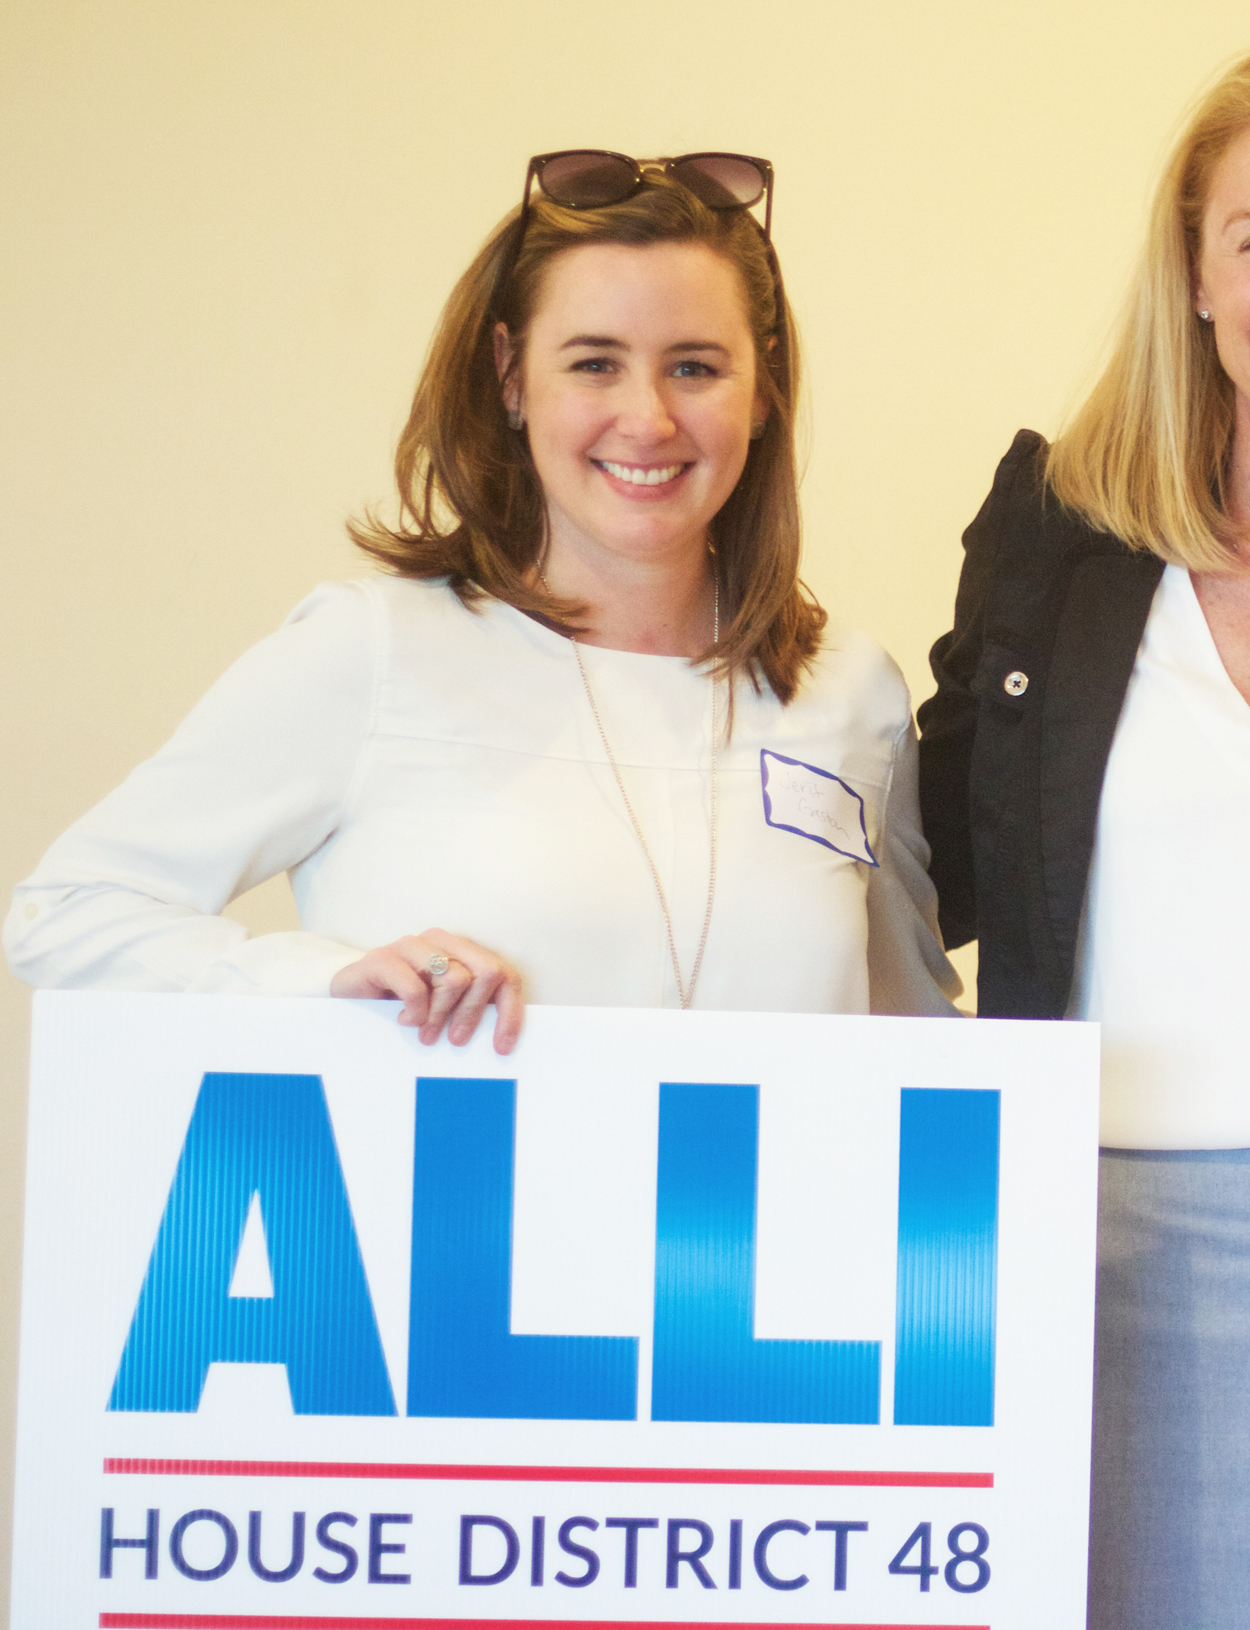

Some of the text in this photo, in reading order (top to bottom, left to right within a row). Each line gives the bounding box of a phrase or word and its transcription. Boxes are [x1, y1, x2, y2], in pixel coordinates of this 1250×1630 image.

[105, 1071, 1001, 1428] ALLI
[99, 1507, 991, 1594] HOUSE DISTRICT 48
